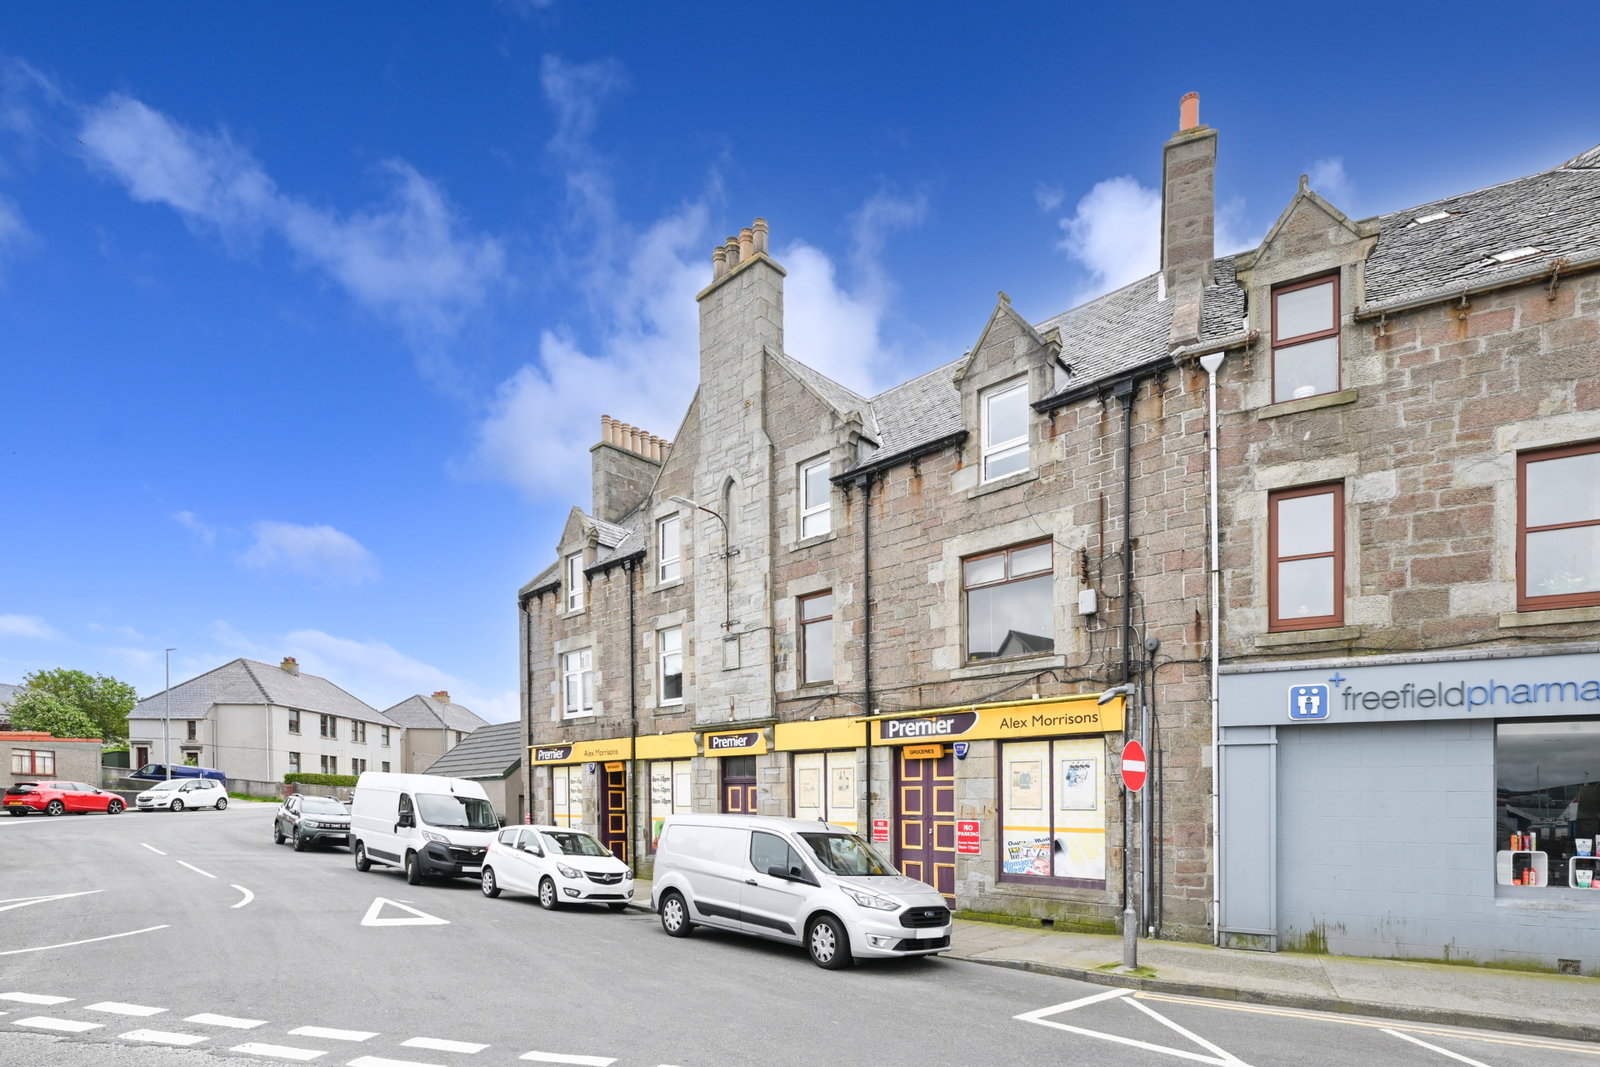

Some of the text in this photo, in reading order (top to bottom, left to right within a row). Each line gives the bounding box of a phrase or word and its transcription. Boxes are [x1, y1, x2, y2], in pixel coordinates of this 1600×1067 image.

[888, 717, 955, 738] Premier
[999, 713, 1099, 729] Alex Morrisons
[712, 734, 748, 749] Premier
[537, 748, 565, 761] Premier
[584, 749, 619, 758] Alex Morrisons
